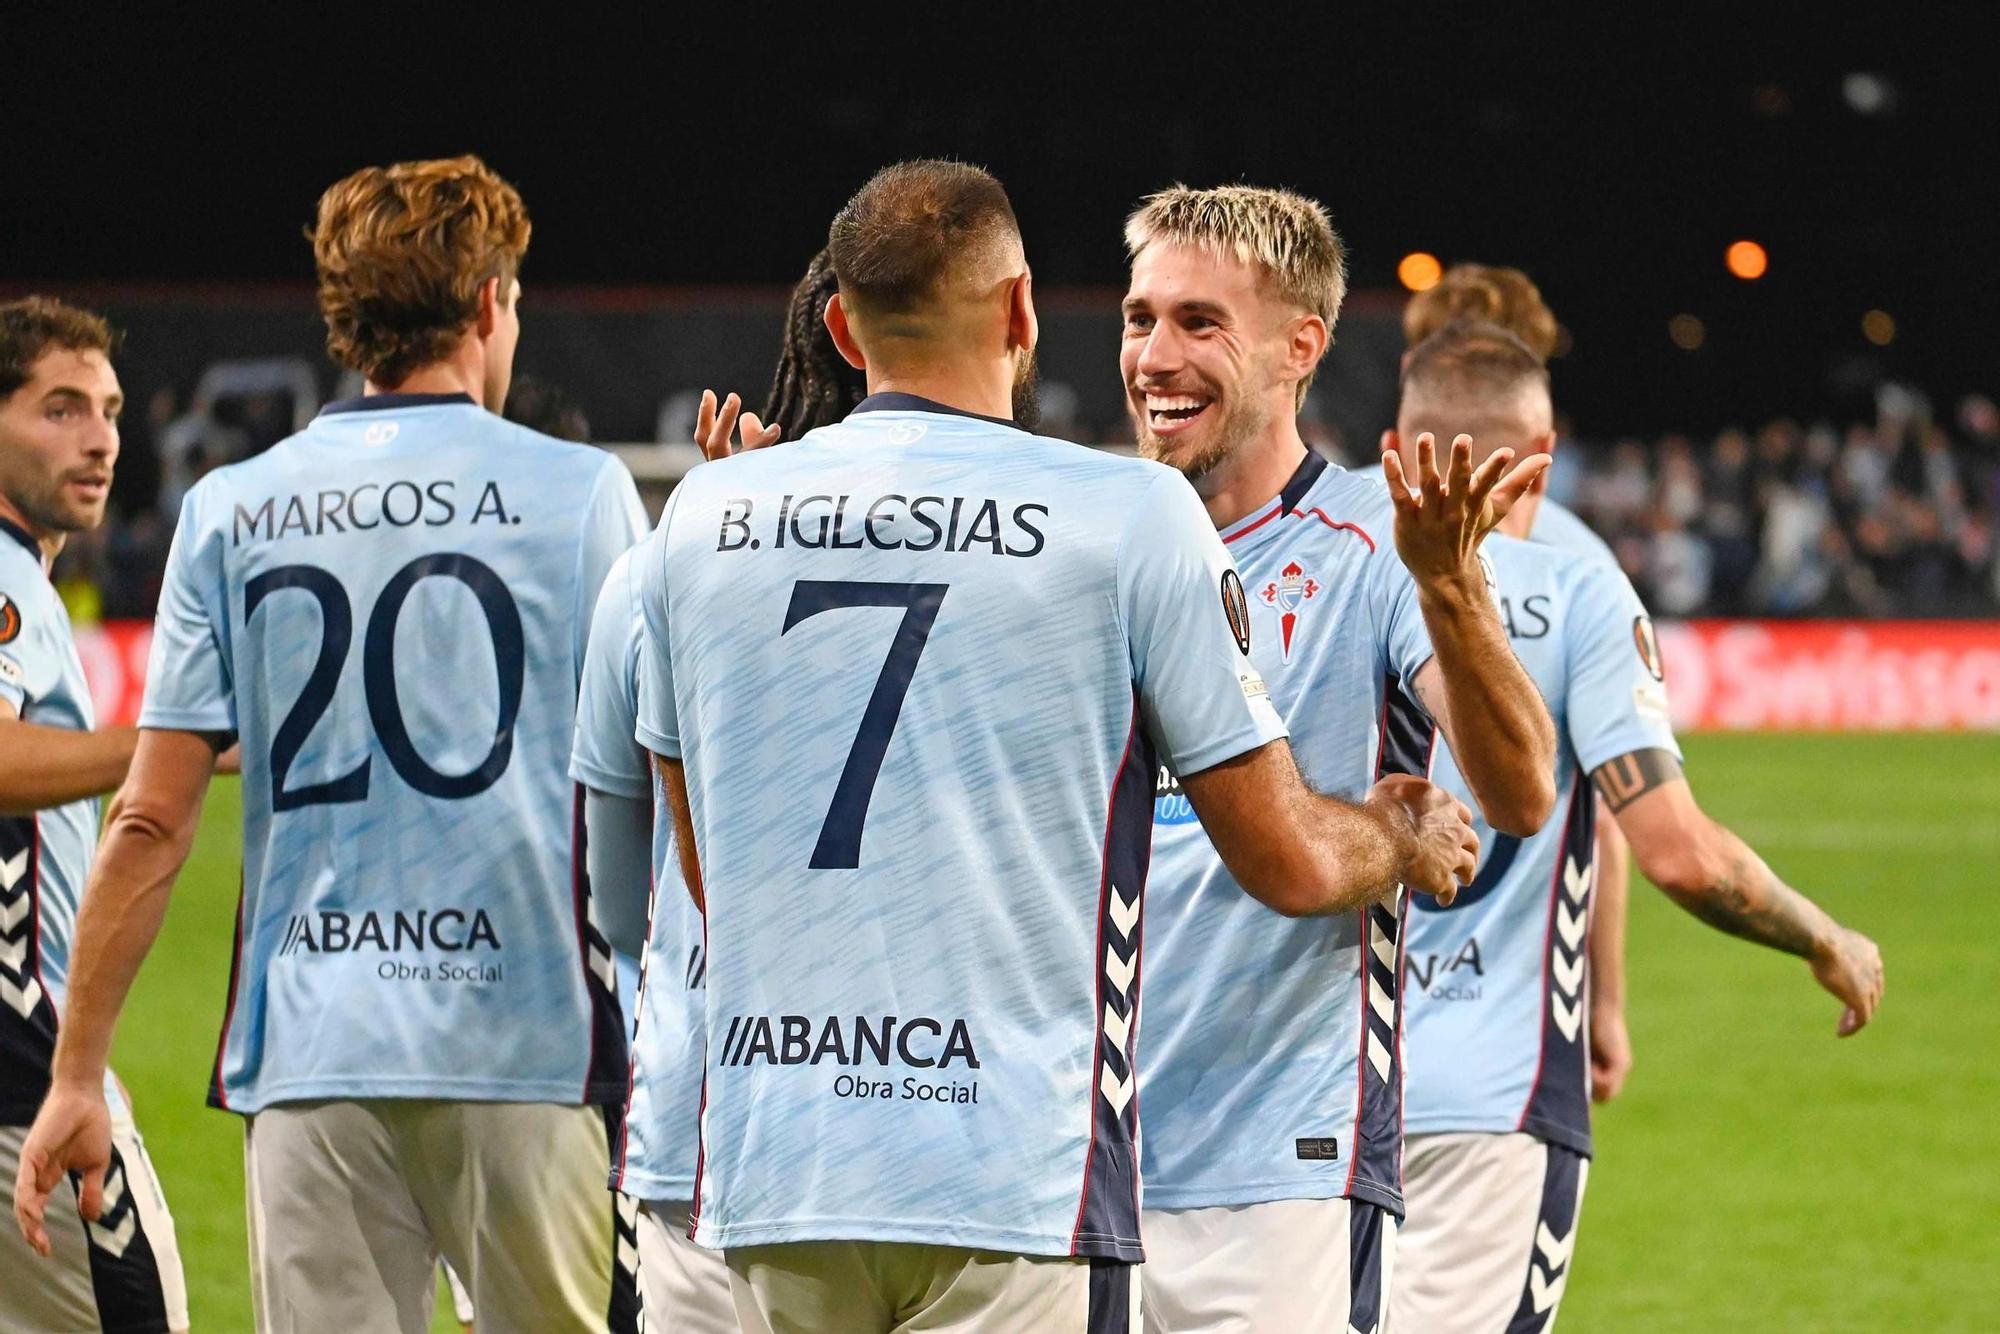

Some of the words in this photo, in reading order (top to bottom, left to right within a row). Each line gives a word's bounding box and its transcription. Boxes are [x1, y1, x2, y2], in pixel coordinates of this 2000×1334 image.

[233, 480, 456, 548] MARCOS
[471, 480, 522, 526] A.
[716, 497, 760, 553] B.
[774, 494, 1049, 558] IGLESIAS
[244, 551, 525, 813] 20
[781, 579, 950, 869] 7
[292, 908, 501, 955] ABANCA
[378, 961, 431, 980] Obra
[438, 961, 503, 982] Social
[1431, 984, 1483, 1001] ocial
[740, 1015, 980, 1069] ABANCA
[834, 1074, 893, 1099] Obra
[901, 1077, 978, 1104] Social
